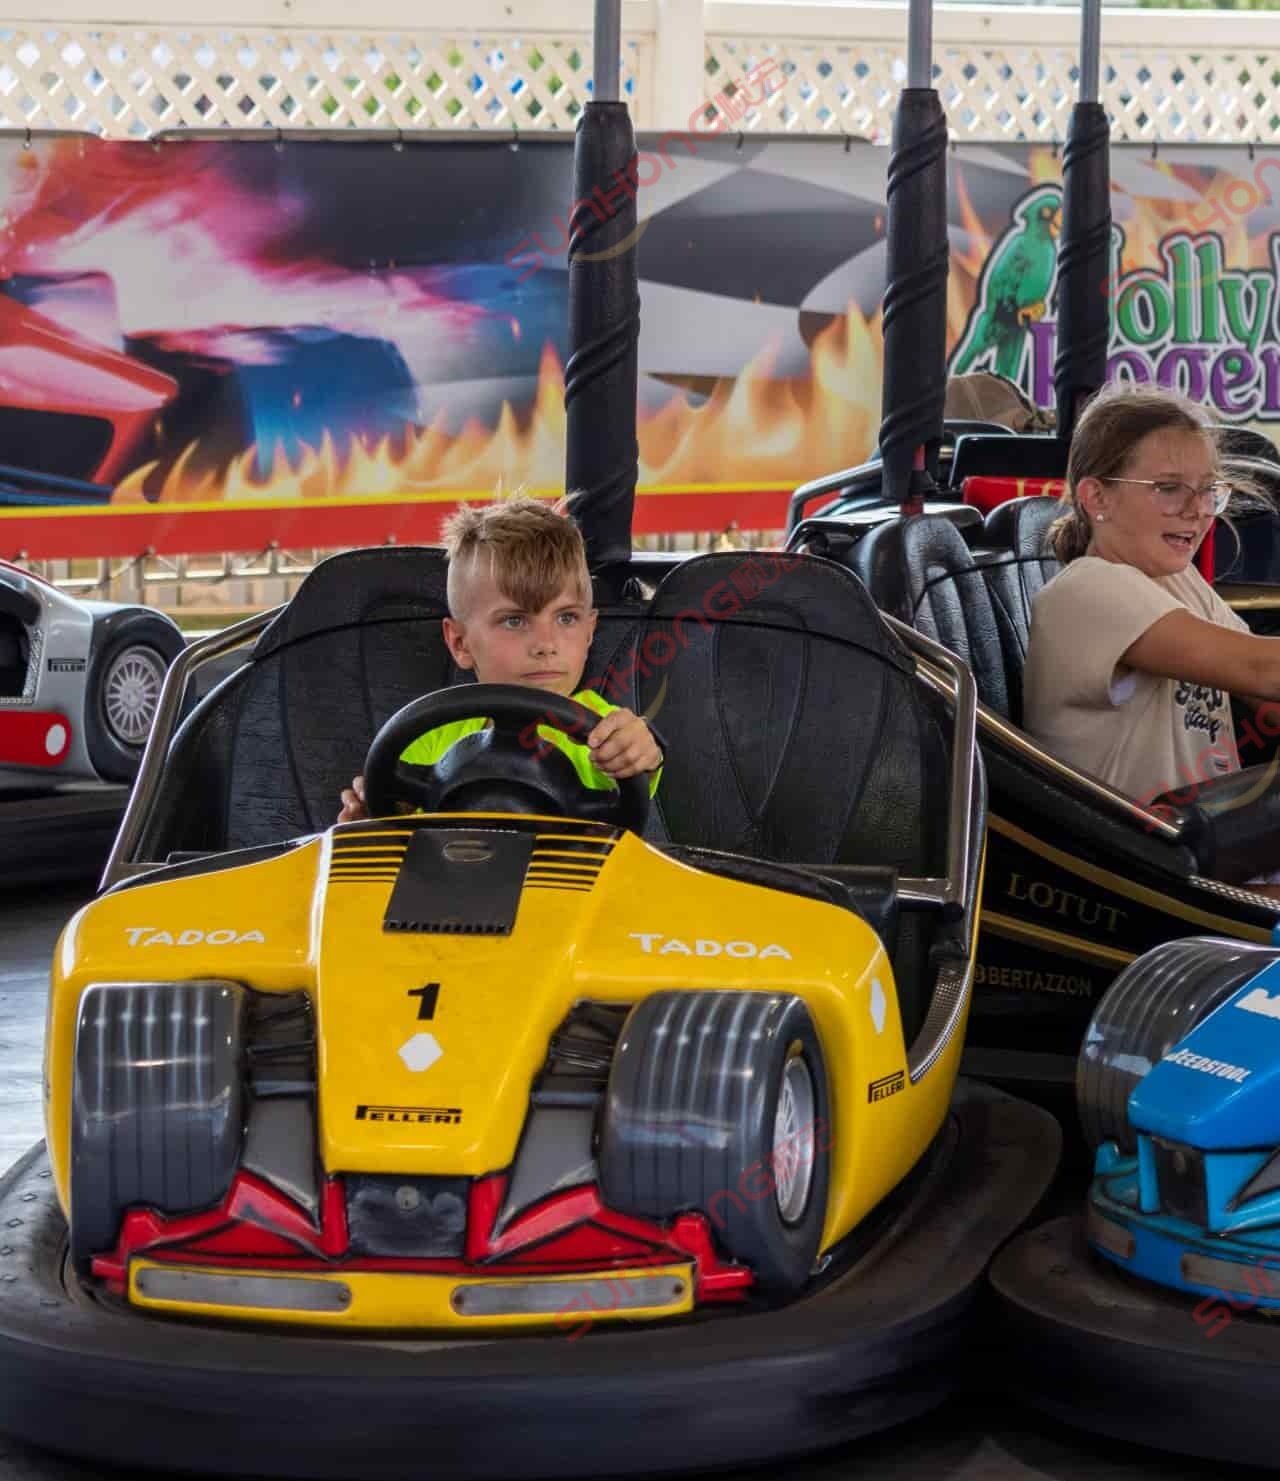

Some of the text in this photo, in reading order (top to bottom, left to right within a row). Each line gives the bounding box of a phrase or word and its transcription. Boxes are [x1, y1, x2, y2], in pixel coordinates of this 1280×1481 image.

[1108, 222, 1273, 352] olly
[1008, 873, 1128, 932] LOTUT
[124, 926, 266, 947] TADOA
[629, 932, 793, 961] TADOA
[407, 982, 441, 1021] 1
